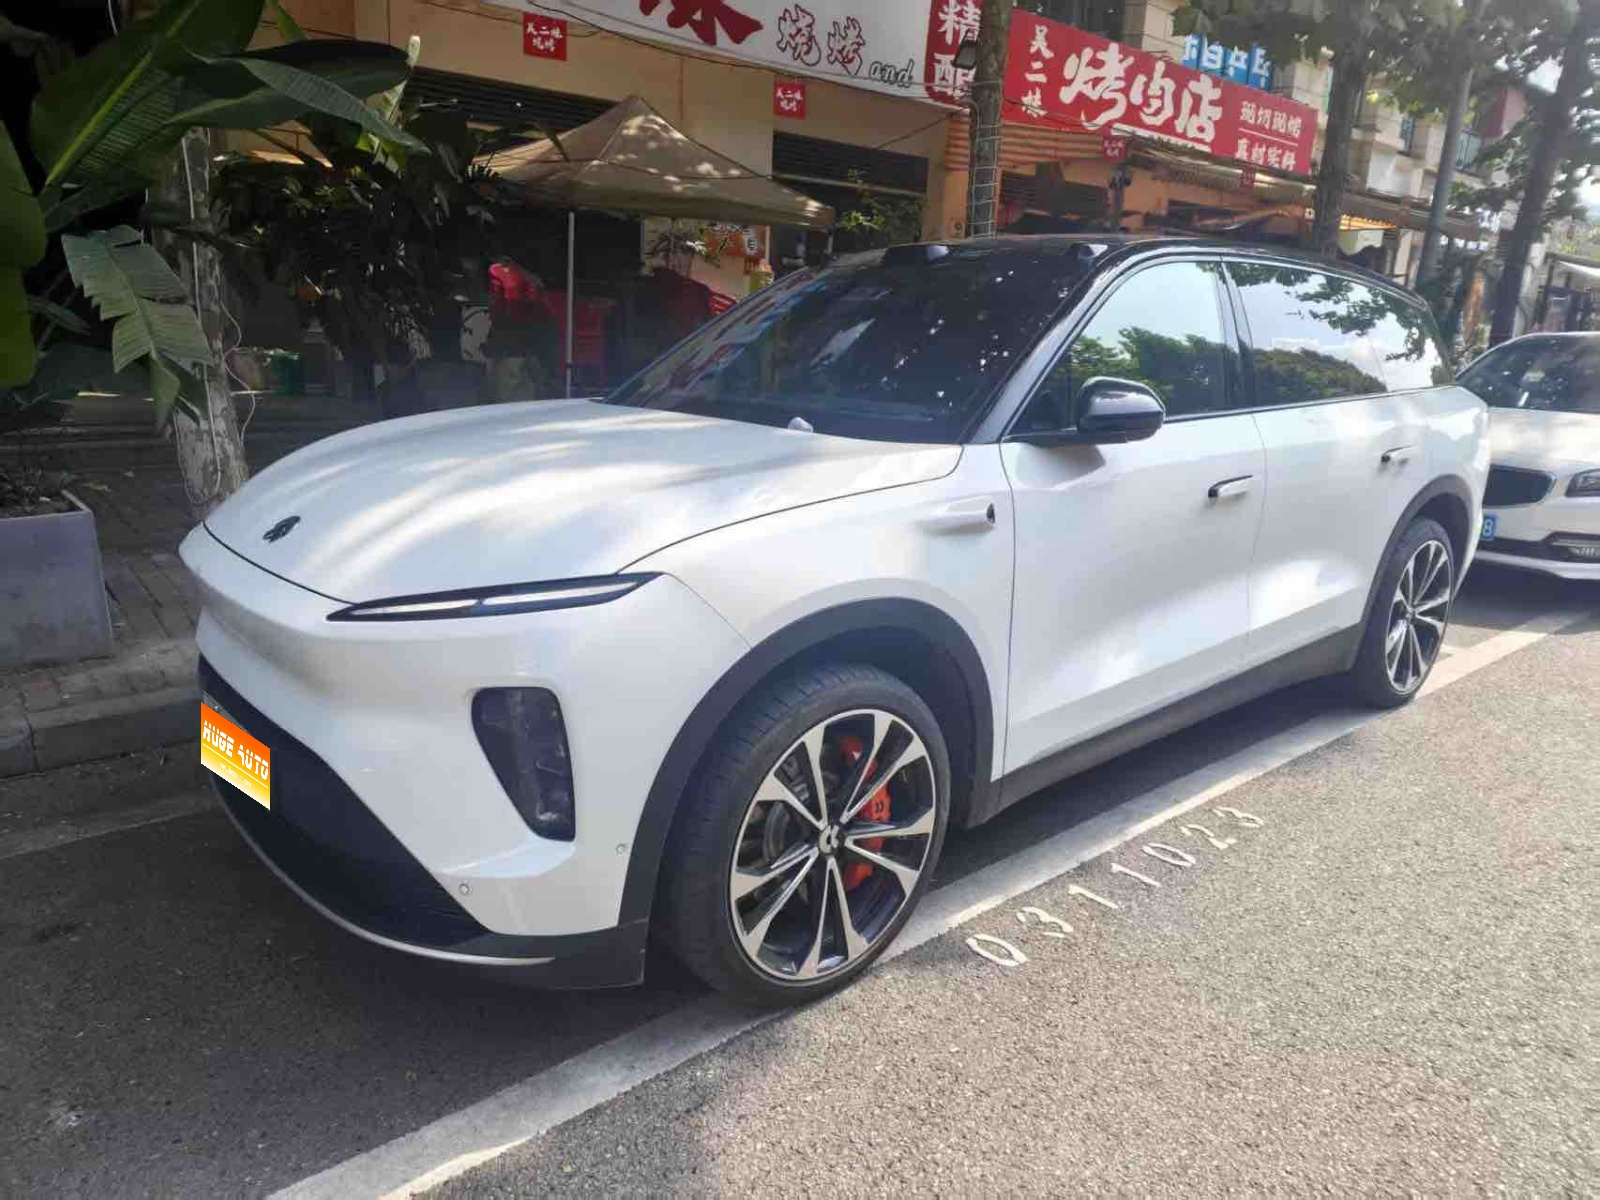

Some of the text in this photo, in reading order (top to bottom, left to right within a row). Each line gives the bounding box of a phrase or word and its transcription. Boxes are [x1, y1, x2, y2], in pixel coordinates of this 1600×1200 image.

[776, 4, 865, 76] 烧烤
[869, 58, 915, 88] and
[1059, 42, 1222, 143] 烤肉店
